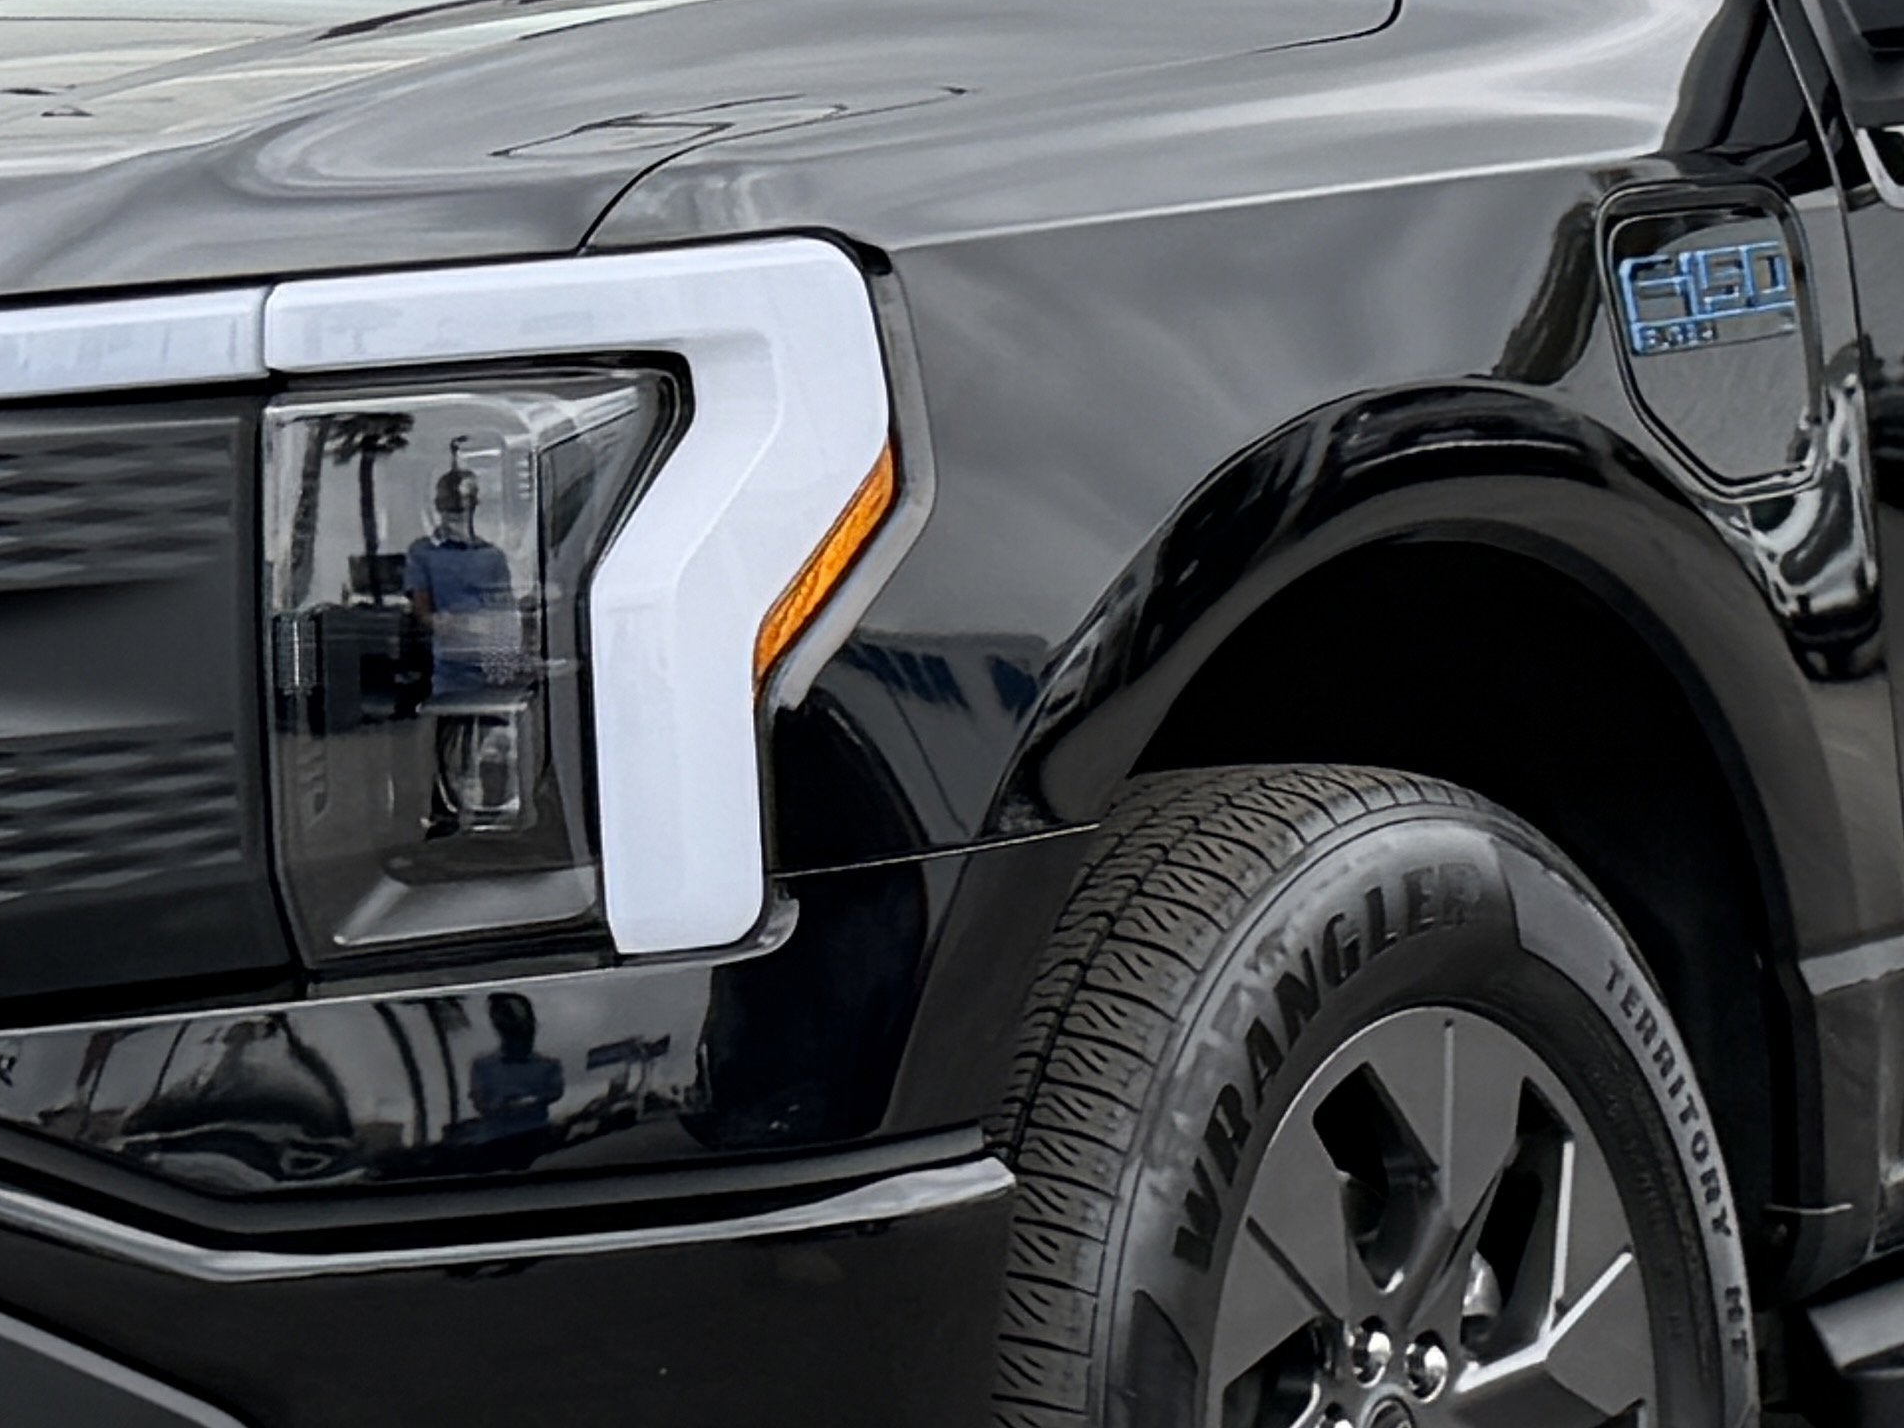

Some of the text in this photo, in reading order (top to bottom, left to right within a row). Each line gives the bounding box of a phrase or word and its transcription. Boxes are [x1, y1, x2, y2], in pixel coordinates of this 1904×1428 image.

[1619, 239, 1796, 356] F-150
[1172, 862, 1483, 1273] WRANGLER
[1603, 959, 1731, 1237] TERRITORY
